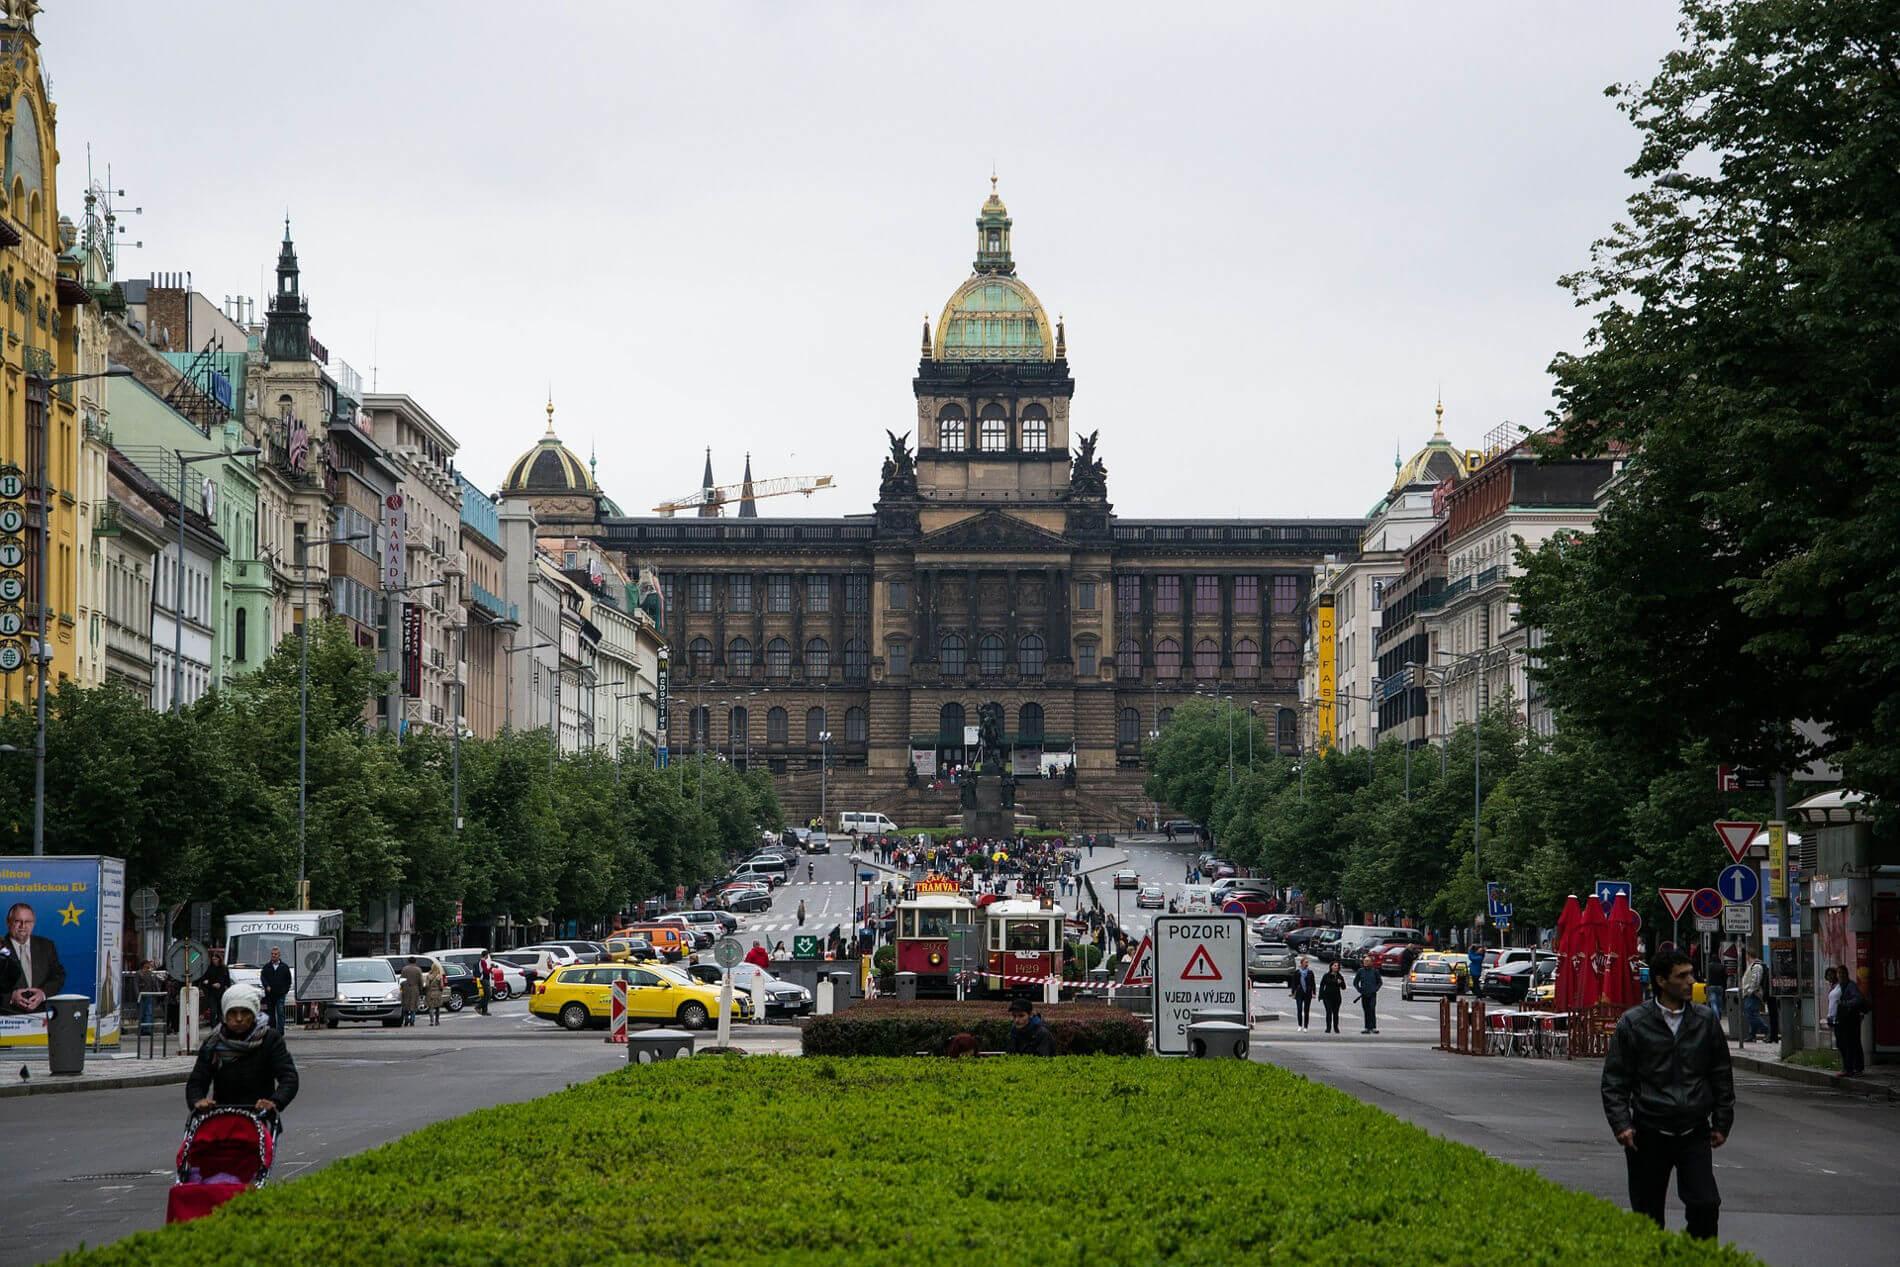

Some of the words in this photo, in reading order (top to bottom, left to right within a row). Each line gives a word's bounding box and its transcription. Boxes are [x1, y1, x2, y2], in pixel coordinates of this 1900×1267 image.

[3, 477, 17, 632] HOTEL
[388, 517, 400, 590] RAMADA
[1321, 619, 1332, 643] DM
[659, 671, 667, 730] McDonalds
[71, 882, 87, 892] EU
[916, 883, 959, 893] TRAMVAJ
[241, 923, 264, 933] CITY
[266, 922, 300, 932] TOURS
[1169, 925, 1230, 939] POZOR!
[1015, 963, 1040, 973] 1429
[1165, 991, 1192, 1003] VJEZD
[1194, 991, 1201, 1003] A
[1203, 989, 1236, 1004] VÝJEZD
[1173, 1008, 1199, 1020] VO
